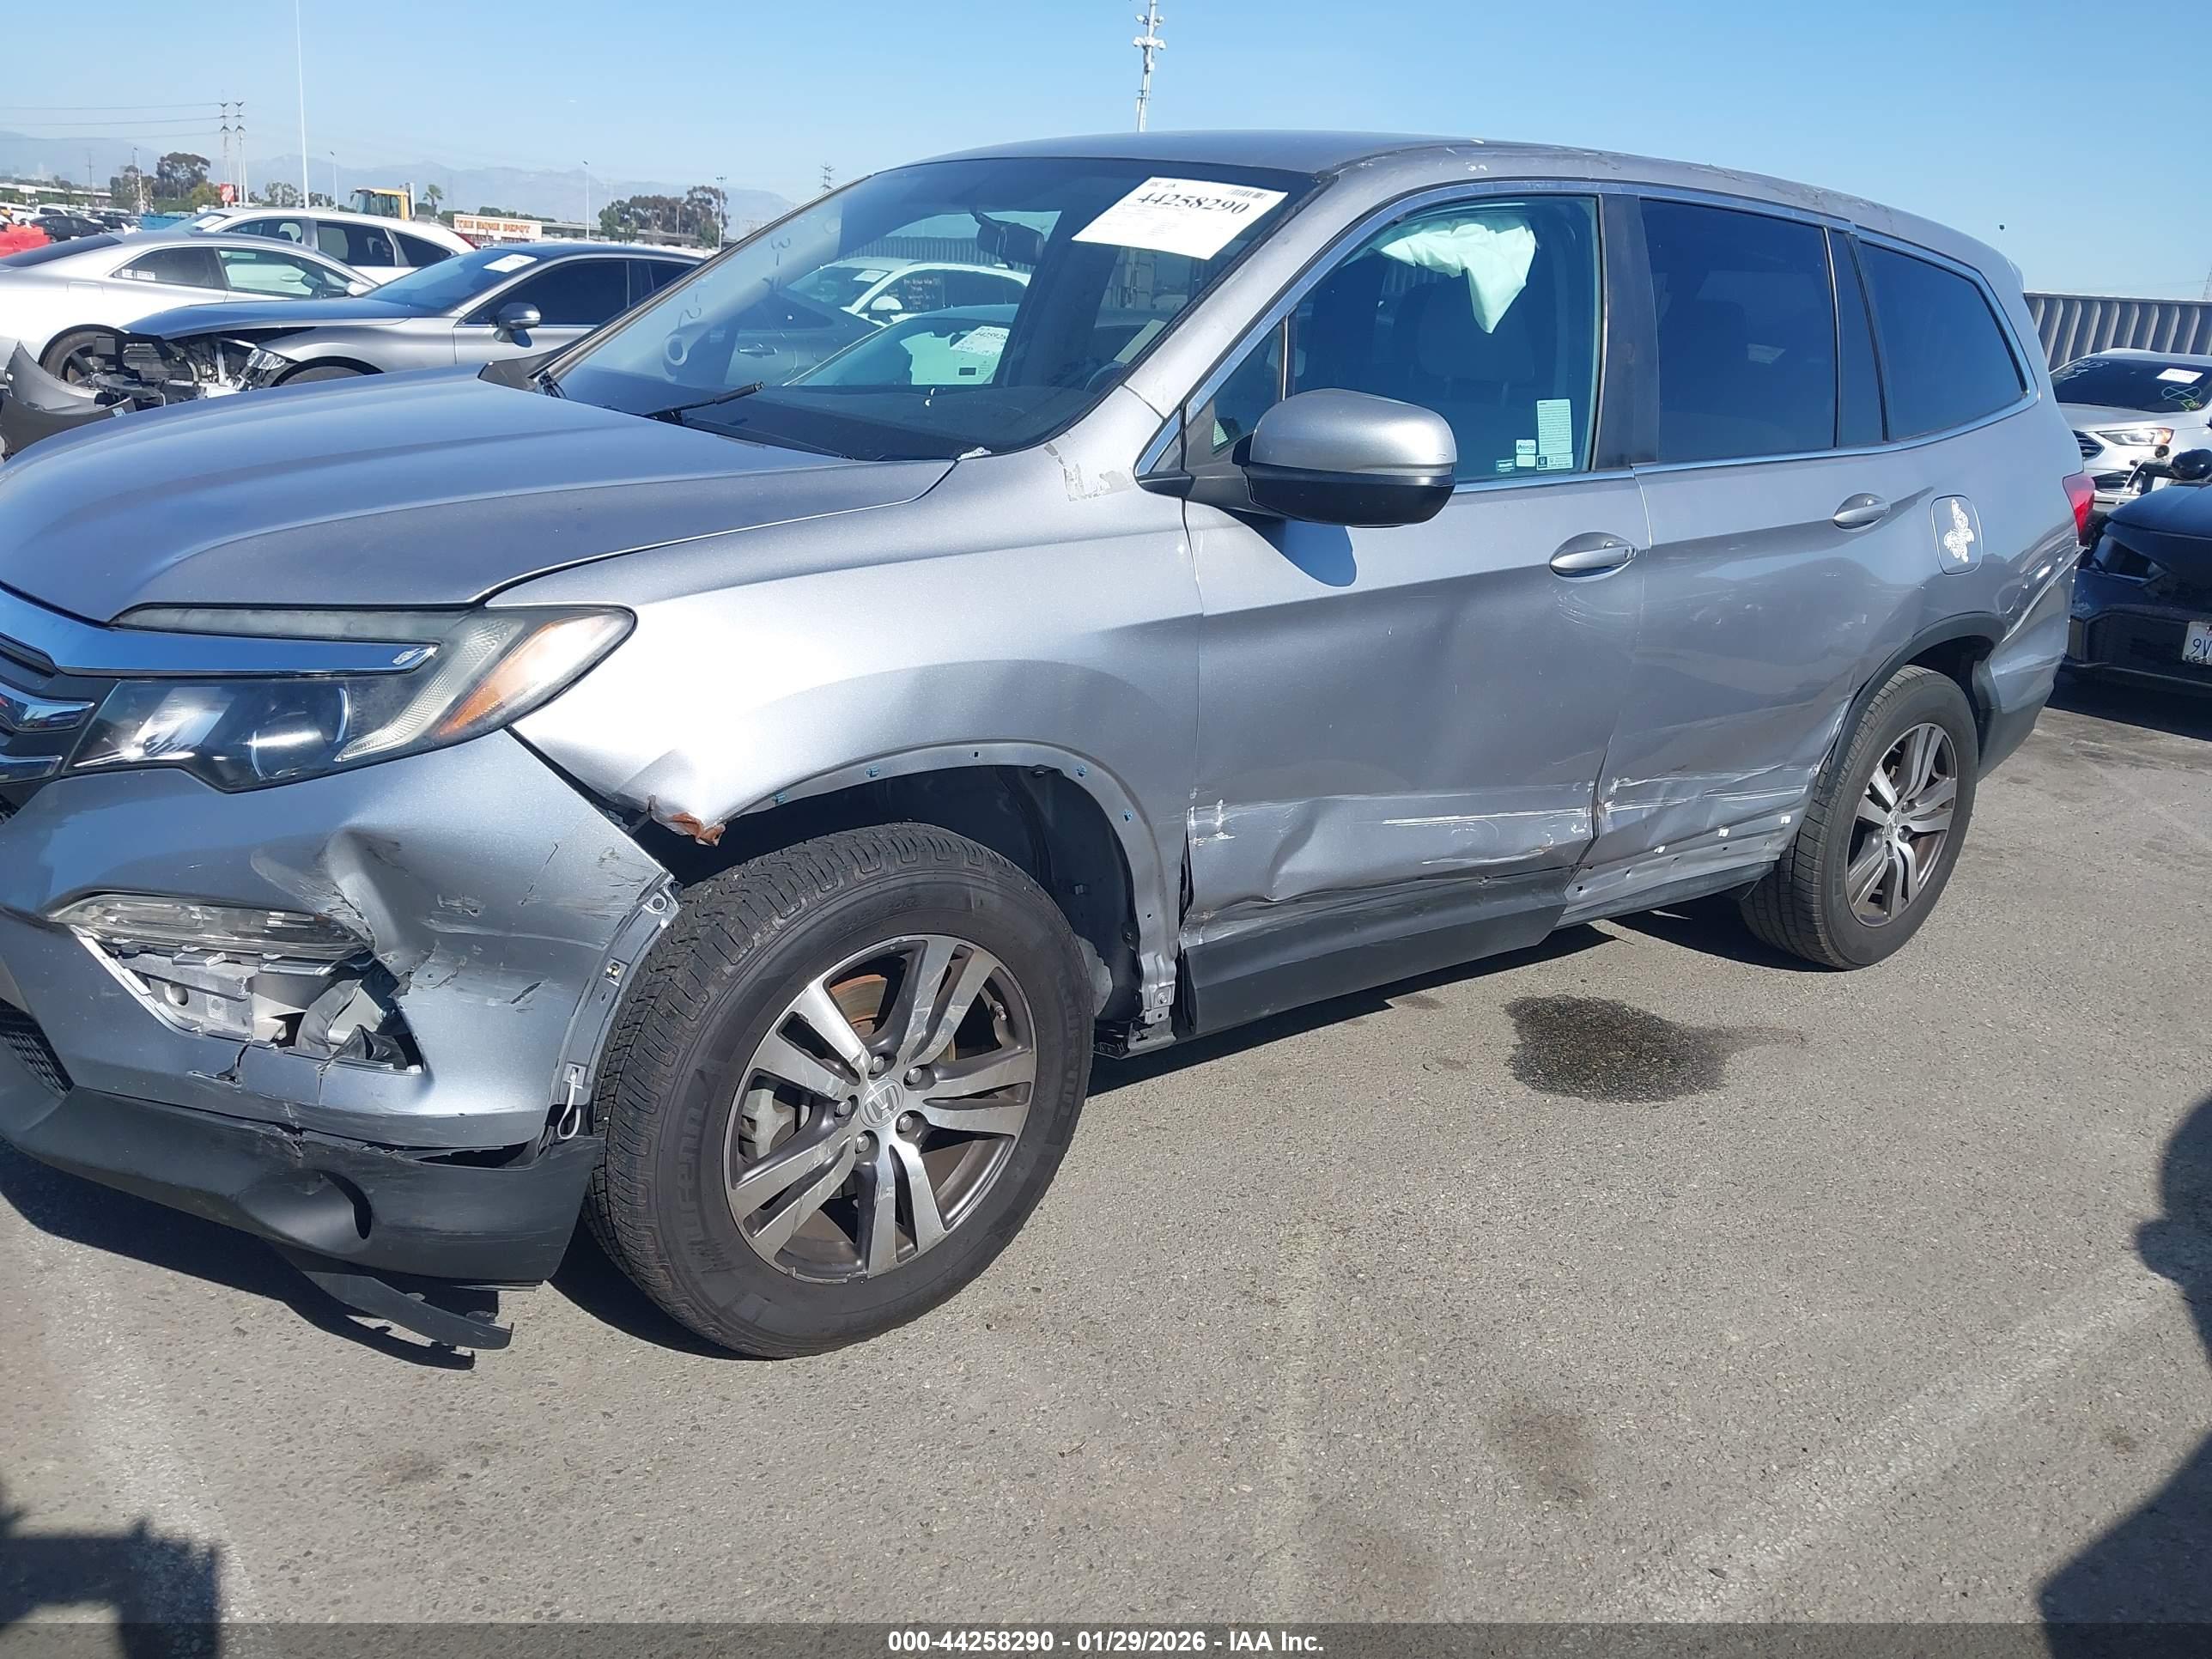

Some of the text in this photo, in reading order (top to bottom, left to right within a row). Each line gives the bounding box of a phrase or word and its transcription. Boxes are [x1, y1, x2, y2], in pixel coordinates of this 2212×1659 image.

[1136, 191, 1251, 215] 44258290
[477, 222, 500, 230] HOME
[503, 223, 530, 233] DEPOT
